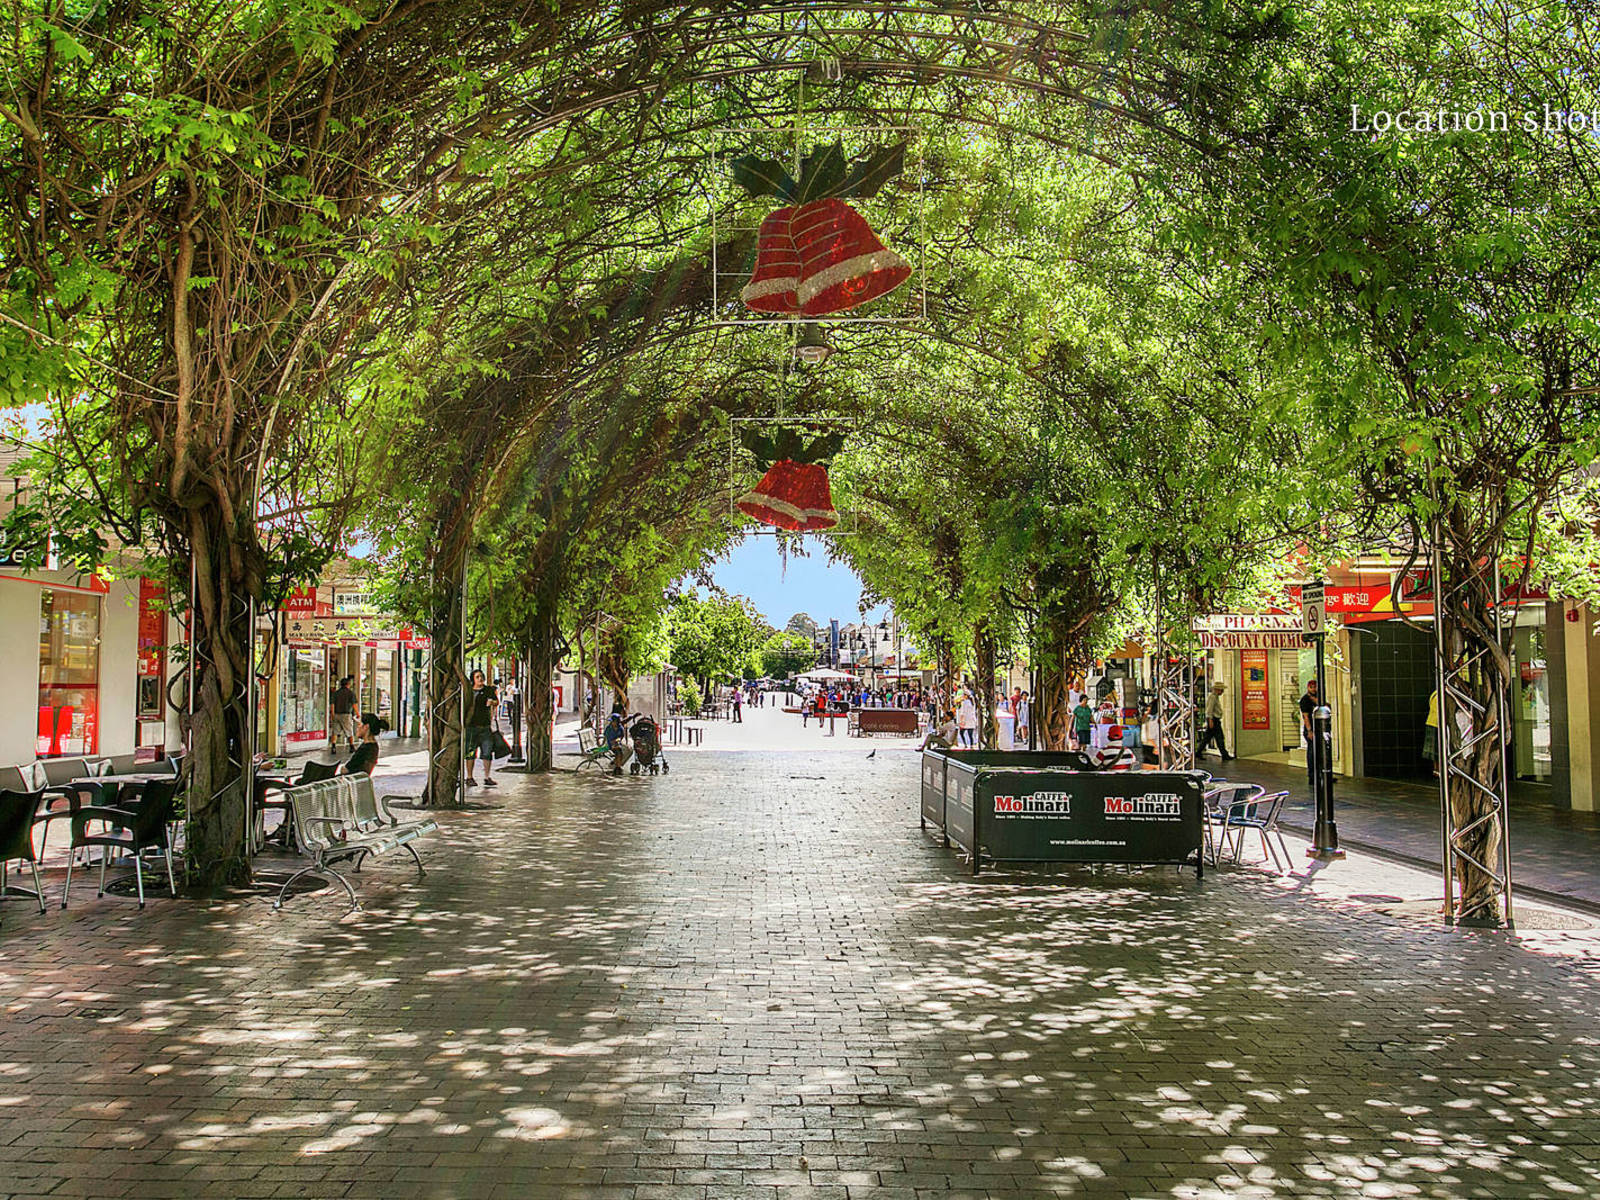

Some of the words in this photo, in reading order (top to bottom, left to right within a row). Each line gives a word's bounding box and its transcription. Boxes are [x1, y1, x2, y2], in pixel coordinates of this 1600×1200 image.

[290, 598, 313, 607] ATM
[1224, 616, 1303, 628] PHARMA
[1201, 632, 1260, 649] DISCOUNT
[995, 797, 1069, 812] Molinari
[1105, 798, 1179, 813] Molinari
